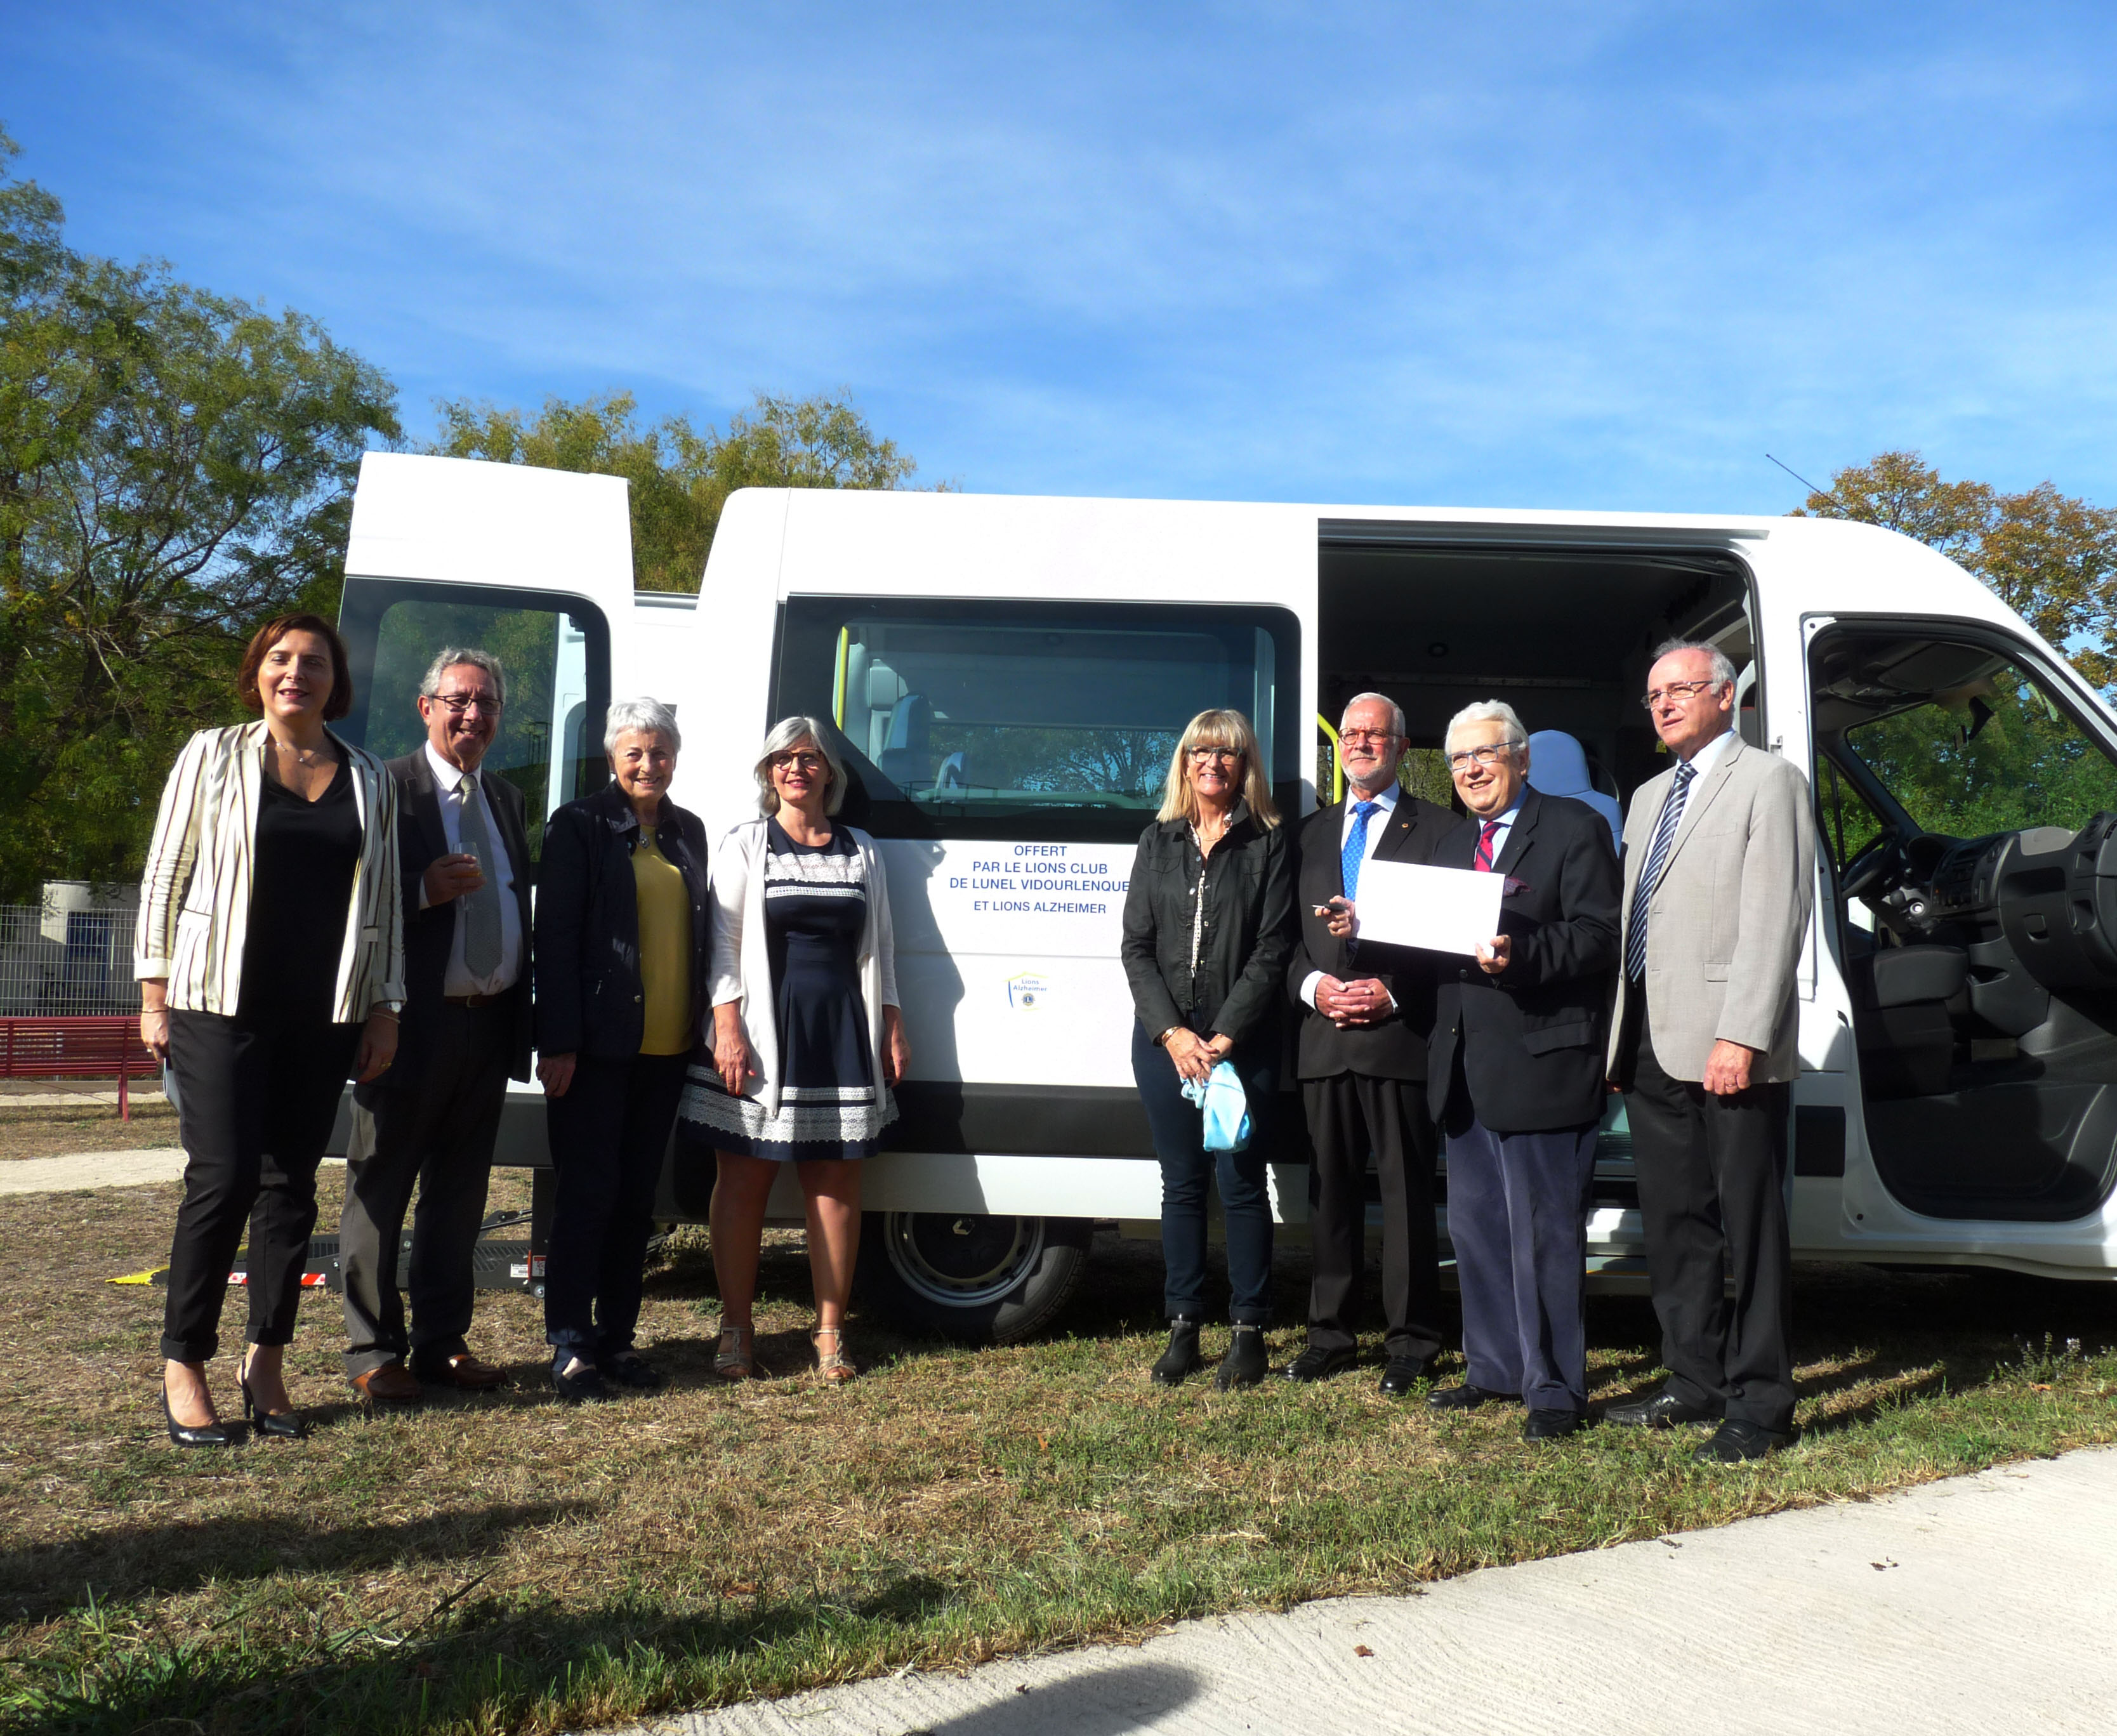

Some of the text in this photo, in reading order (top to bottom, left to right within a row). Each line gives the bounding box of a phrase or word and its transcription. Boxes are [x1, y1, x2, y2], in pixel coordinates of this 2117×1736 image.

[1014, 845, 1067, 857] OFFERT
[973, 861, 1107, 874] PAR LE LIONS CLUB
[950, 878, 1130, 891] DE LUNEL VIDOURLENQUE
[974, 901, 1106, 914] ET LIONS ALZHEIMER
